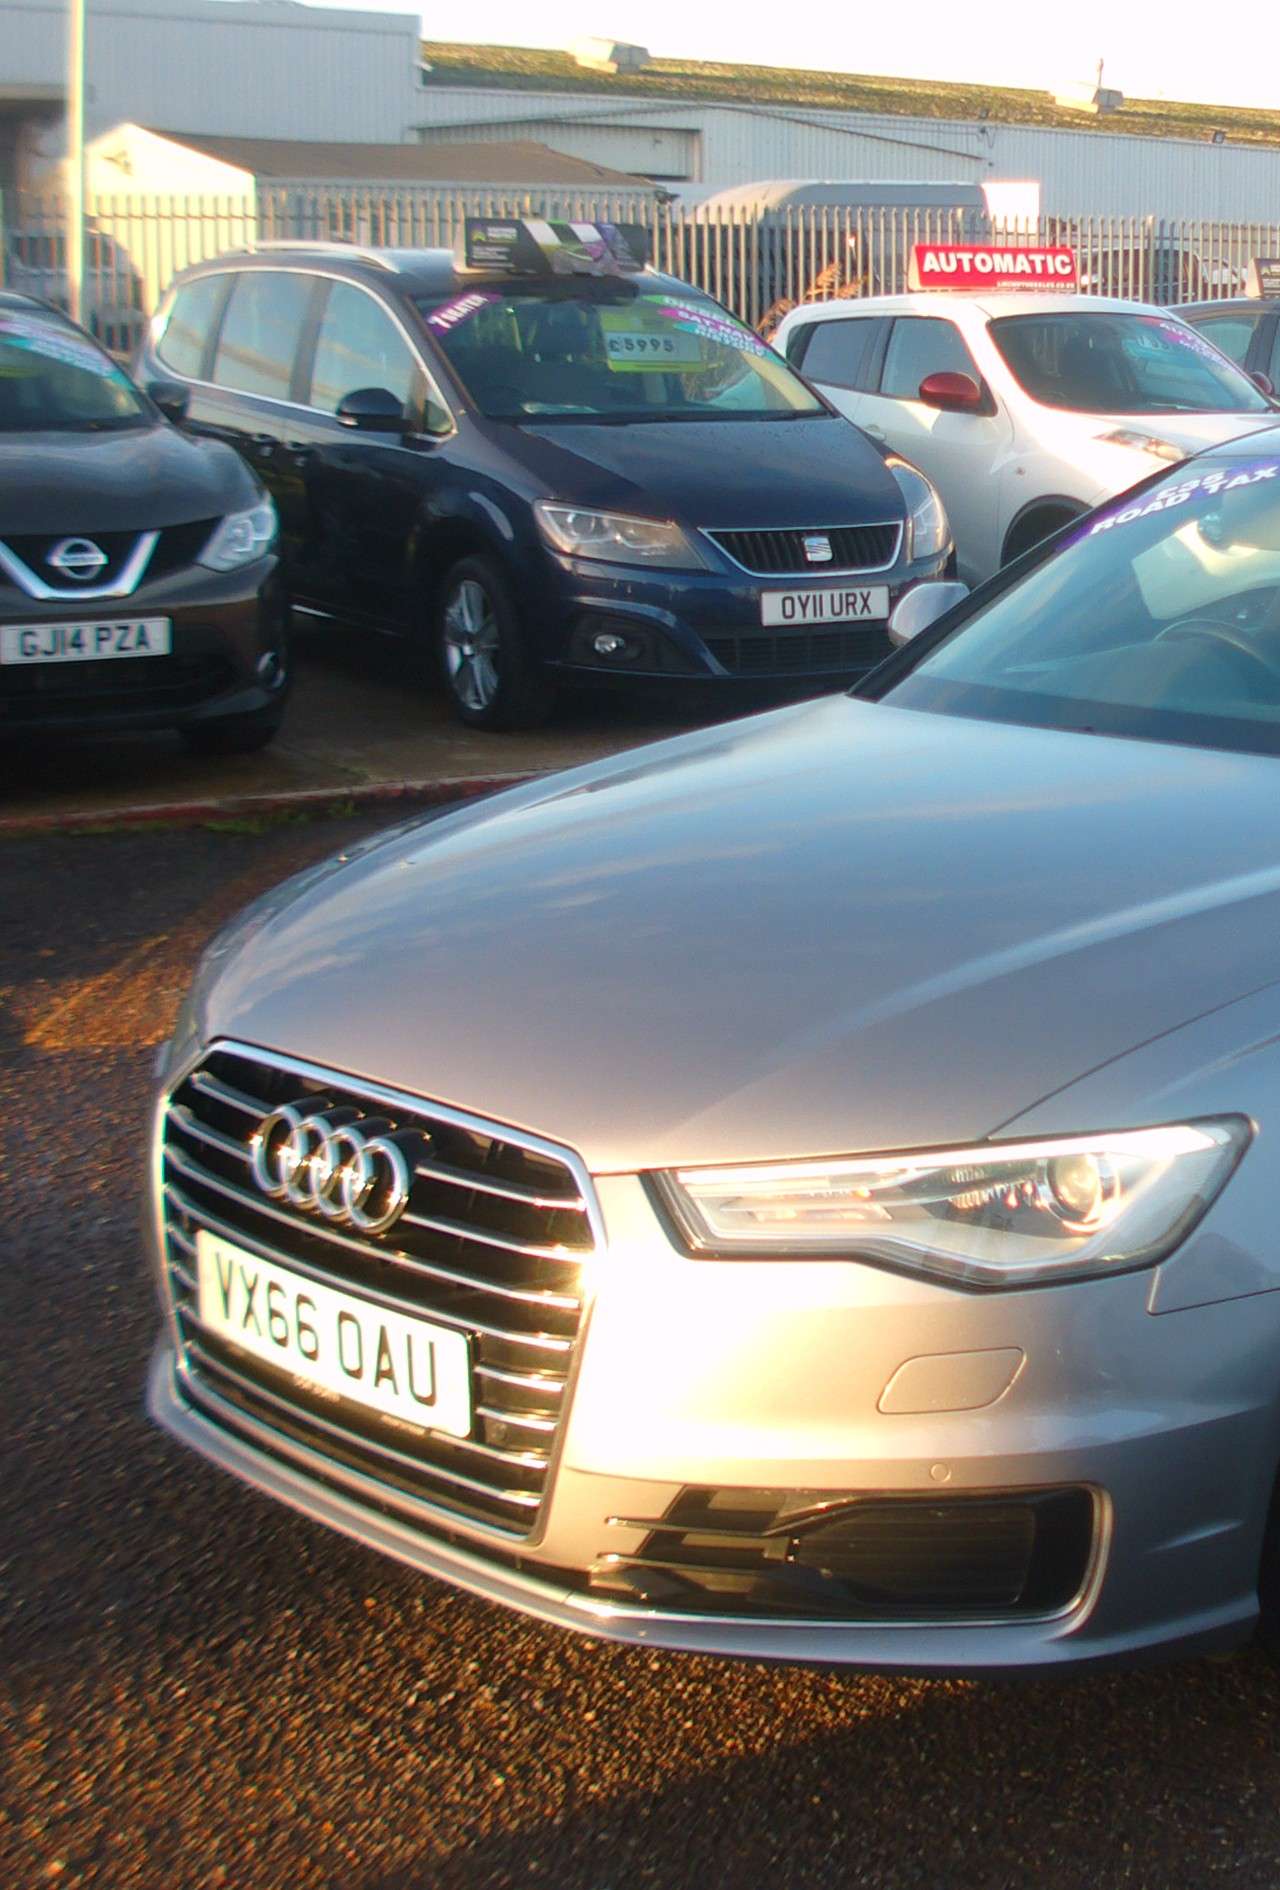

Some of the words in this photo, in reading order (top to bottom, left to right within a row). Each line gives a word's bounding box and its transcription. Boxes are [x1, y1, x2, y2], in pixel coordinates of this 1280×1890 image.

[922, 251, 1073, 276] AUTOMATIC
[608, 338, 675, 353] £5995
[1089, 491, 1191, 535] ROAD
[1203, 465, 1280, 495] TAX
[830, 590, 872, 617] URX
[19, 626, 85, 657] GJ14
[95, 623, 150, 654] PZA
[215, 1251, 319, 1362] VX66
[337, 1309, 437, 1408] OAU
